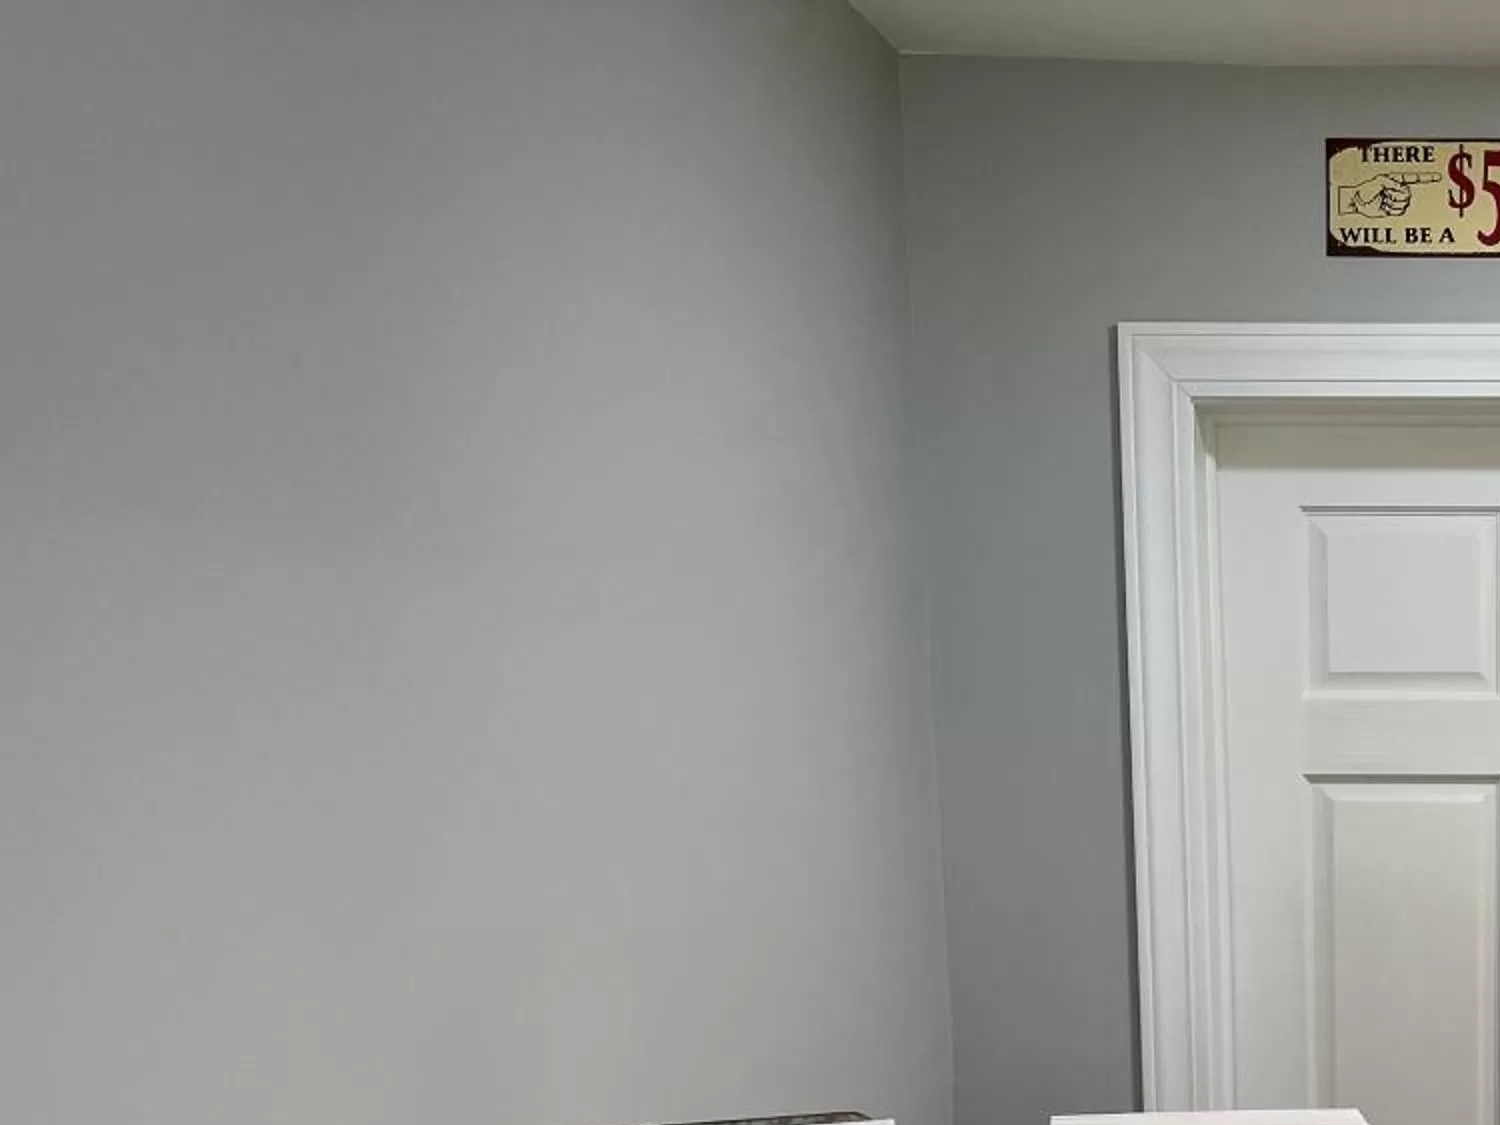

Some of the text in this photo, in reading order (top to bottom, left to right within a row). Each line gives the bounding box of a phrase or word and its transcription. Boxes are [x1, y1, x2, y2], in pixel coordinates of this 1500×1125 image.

[1358, 145, 1435, 163] THERE
[1339, 228, 1455, 244] WILL BE A
